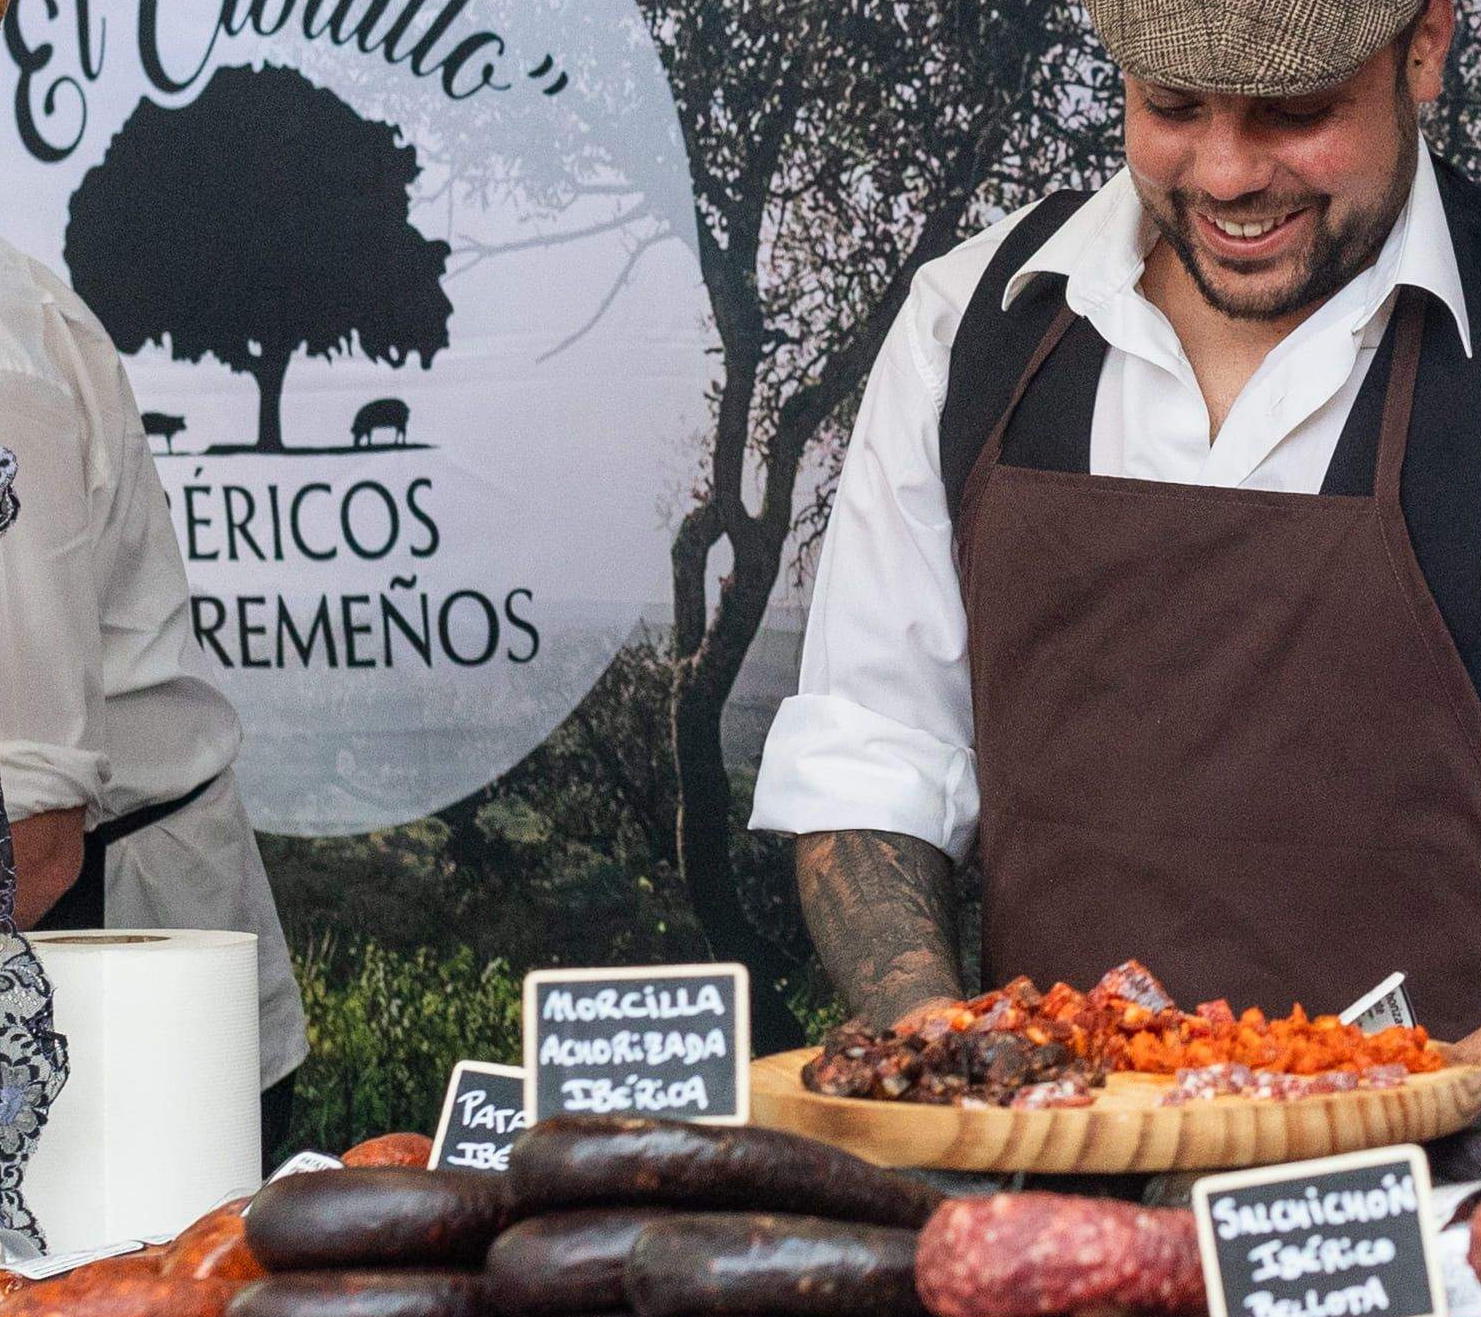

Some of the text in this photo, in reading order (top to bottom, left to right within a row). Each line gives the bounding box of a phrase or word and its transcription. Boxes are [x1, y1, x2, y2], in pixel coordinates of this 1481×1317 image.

[167, 467, 441, 562] ÉRICOS
[542, 984, 725, 1022] MORCILLA
[540, 1028, 727, 1067] ACHORIZADA
[562, 1074, 709, 1114] IBÉRICA
